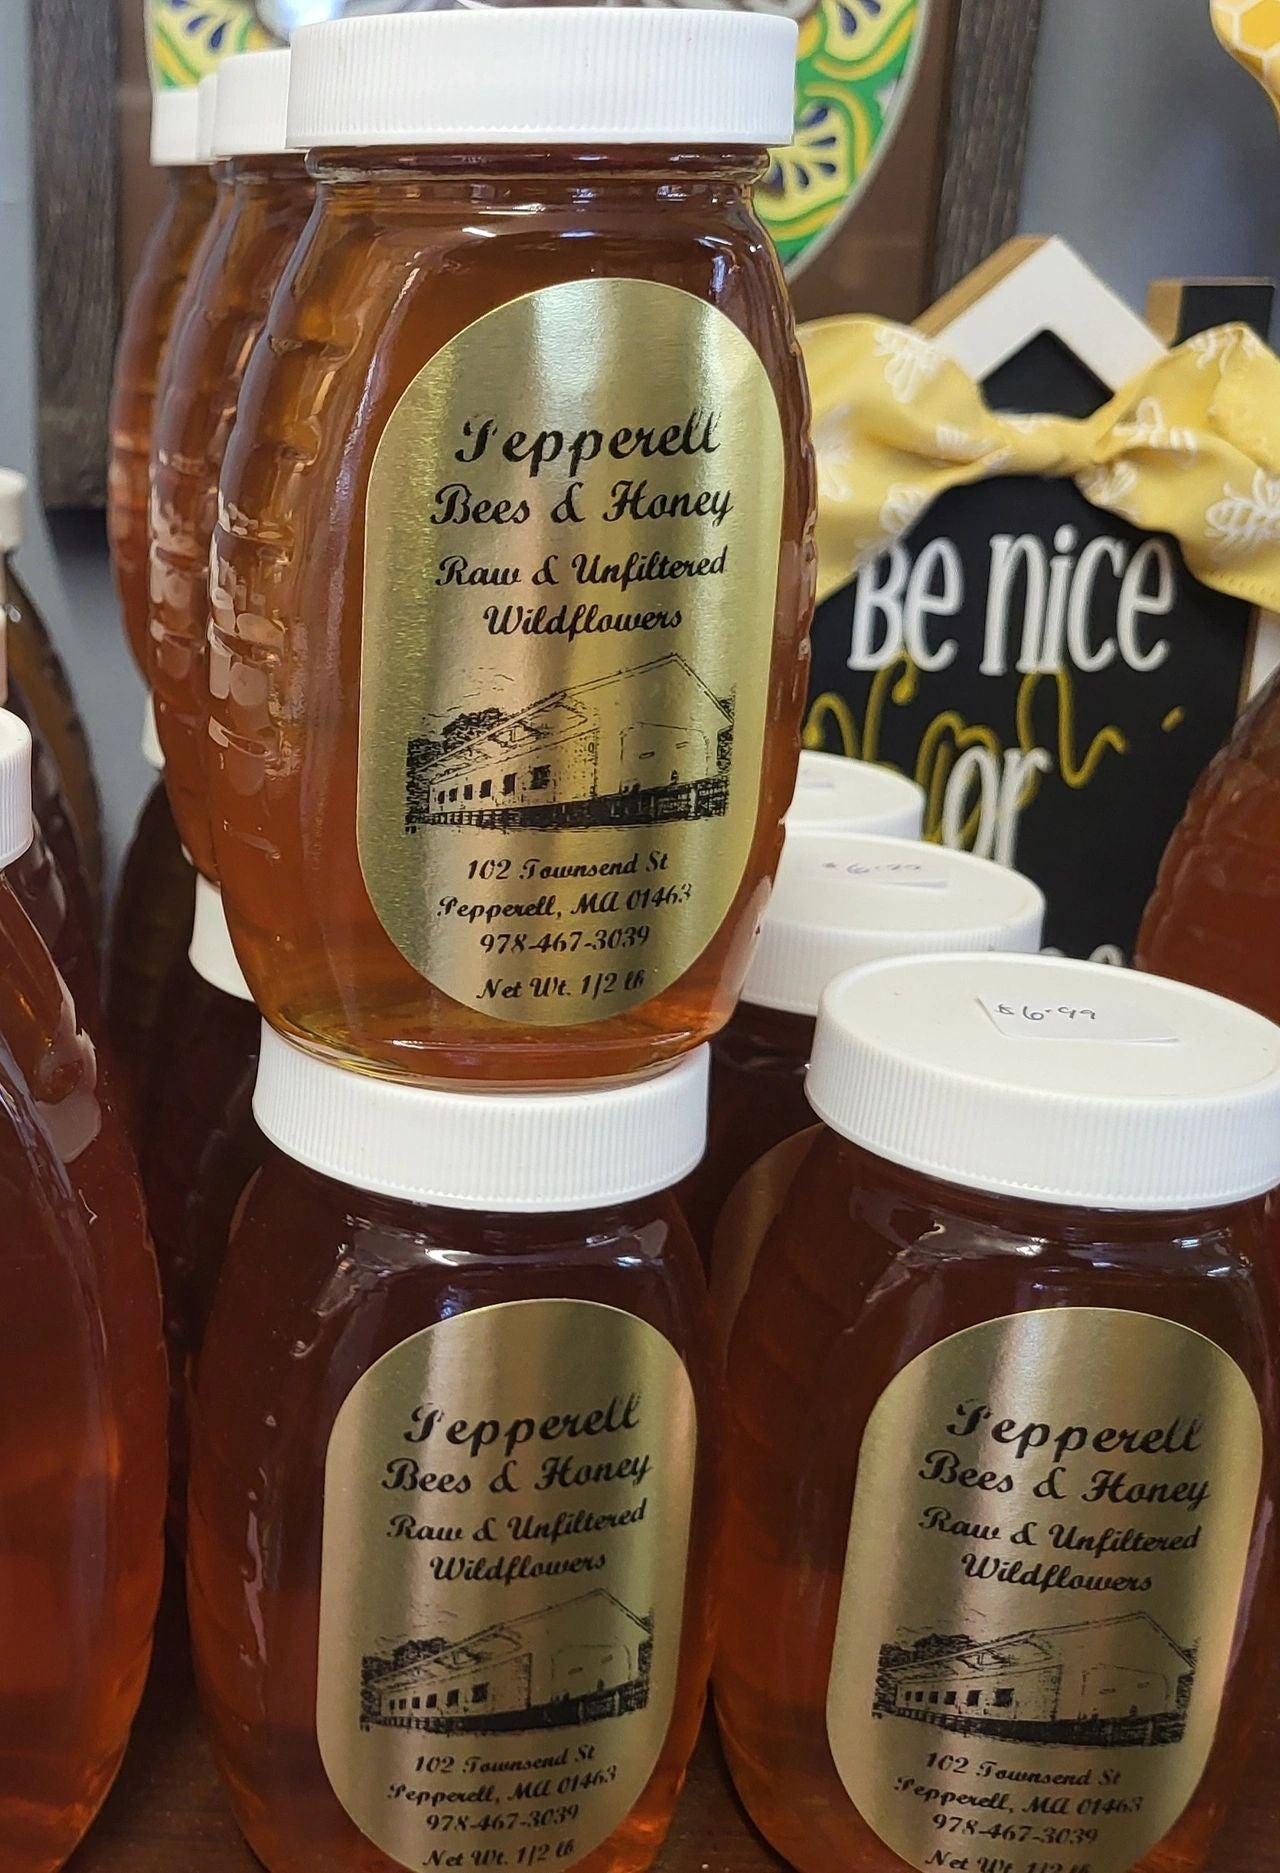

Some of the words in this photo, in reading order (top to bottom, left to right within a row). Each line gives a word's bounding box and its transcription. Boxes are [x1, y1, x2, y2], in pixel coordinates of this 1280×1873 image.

[454, 409, 723, 477] Pepperell
[430, 483, 531, 524] Bees
[550, 482, 585, 524] &
[602, 479, 734, 528] Honey
[435, 554, 522, 587] Raw
[532, 554, 560, 585] &
[570, 545, 729, 591] Unfiltered
[846, 537, 967, 673] Be
[979, 524, 1177, 676] nice
[483, 603, 682, 642] Wildflowers
[467, 858, 512, 879] 102
[519, 853, 639, 879] Townsend
[645, 850, 669, 872] St
[437, 895, 562, 923] Pepperell,
[570, 893, 620, 914] MA
[626, 882, 693, 910] 01463
[480, 925, 650, 954] 978-467-3039
[476, 978, 523, 999] Net
[529, 976, 571, 997] Wt.
[581, 973, 618, 1000] 1/2
[404, 1391, 642, 1457] Pepperell
[946, 1398, 1205, 1462] Pepperell
[381, 1457, 472, 1493] Bees
[489, 1459, 519, 1493] &
[534, 1454, 654, 1488] Honey
[918, 1449, 1014, 1492] Bees
[1032, 1467, 1066, 1499] &
[1081, 1469, 1211, 1511] Honey
[386, 1514, 465, 1542] Raw
[472, 1517, 498, 1542] &
[507, 1498, 648, 1544] Unfiltered
[918, 1506, 1000, 1539] Raw
[1010, 1522, 1037, 1546] &
[1048, 1523, 1202, 1557] Unfiltered
[429, 1553, 607, 1586] Wildflowers
[961, 1552, 1153, 1593] Wildflowers
[414, 1755, 456, 1774] 102
[462, 1748, 569, 1774] Townsend
[573, 1744, 595, 1763] St
[925, 1752, 970, 1774] 102
[976, 1760, 1093, 1786] Townsend
[1098, 1768, 1121, 1786] St
[388, 1783, 501, 1807] Pepperell,
[507, 1780, 553, 1802] MA
[556, 1765, 617, 1794] 01463
[894, 1775, 1014, 1813] Pepperell,
[1022, 1796, 1068, 1815] MA
[1076, 1796, 1143, 1815] 01463
[426, 1804, 579, 1832] 978-467-3039
[932, 1813, 1099, 1844] 978-467-3039
[422, 1850, 464, 1866] Net
[470, 1849, 508, 1866] Wt.
[517, 1844, 550, 1866] 1/2
[924, 1849, 968, 1870] Net
